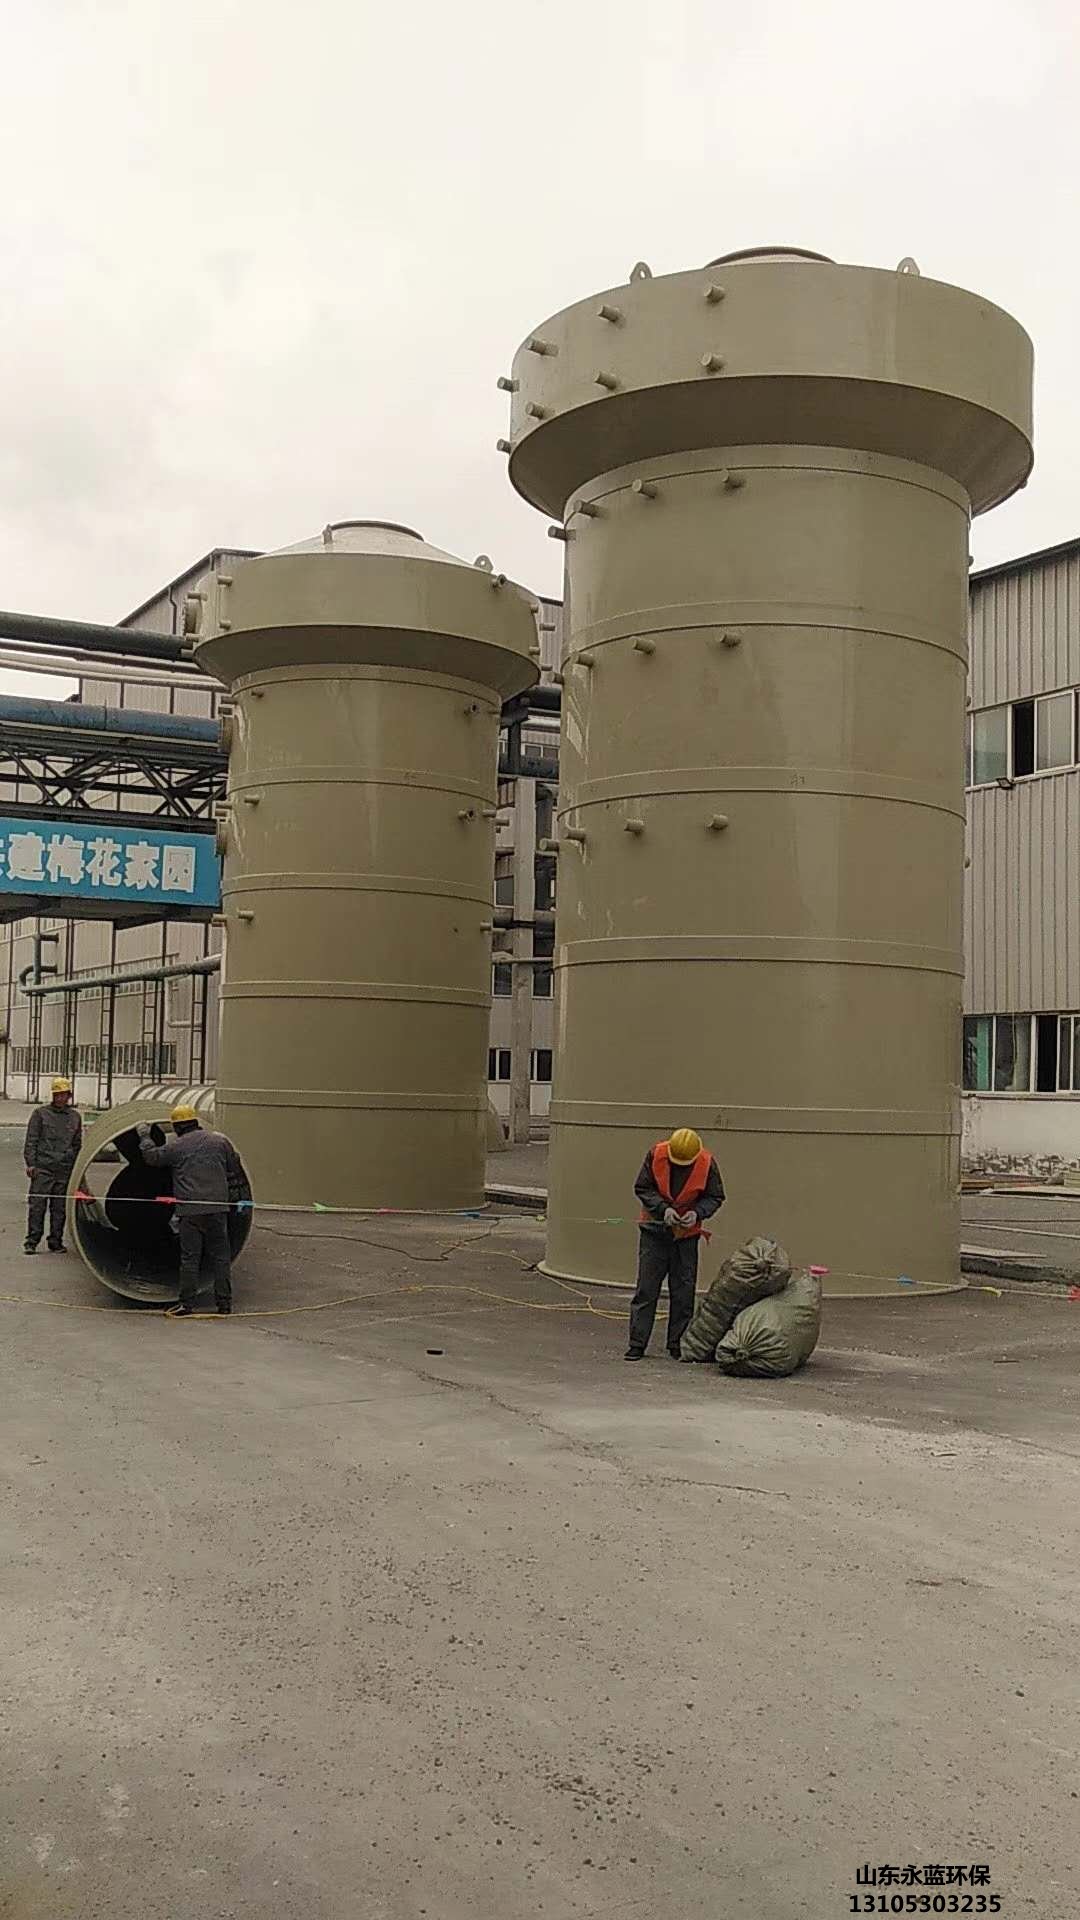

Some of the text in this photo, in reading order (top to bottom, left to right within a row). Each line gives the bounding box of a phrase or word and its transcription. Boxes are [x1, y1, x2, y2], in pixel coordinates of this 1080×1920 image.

[0, 832, 196, 893] 建梅花家园
